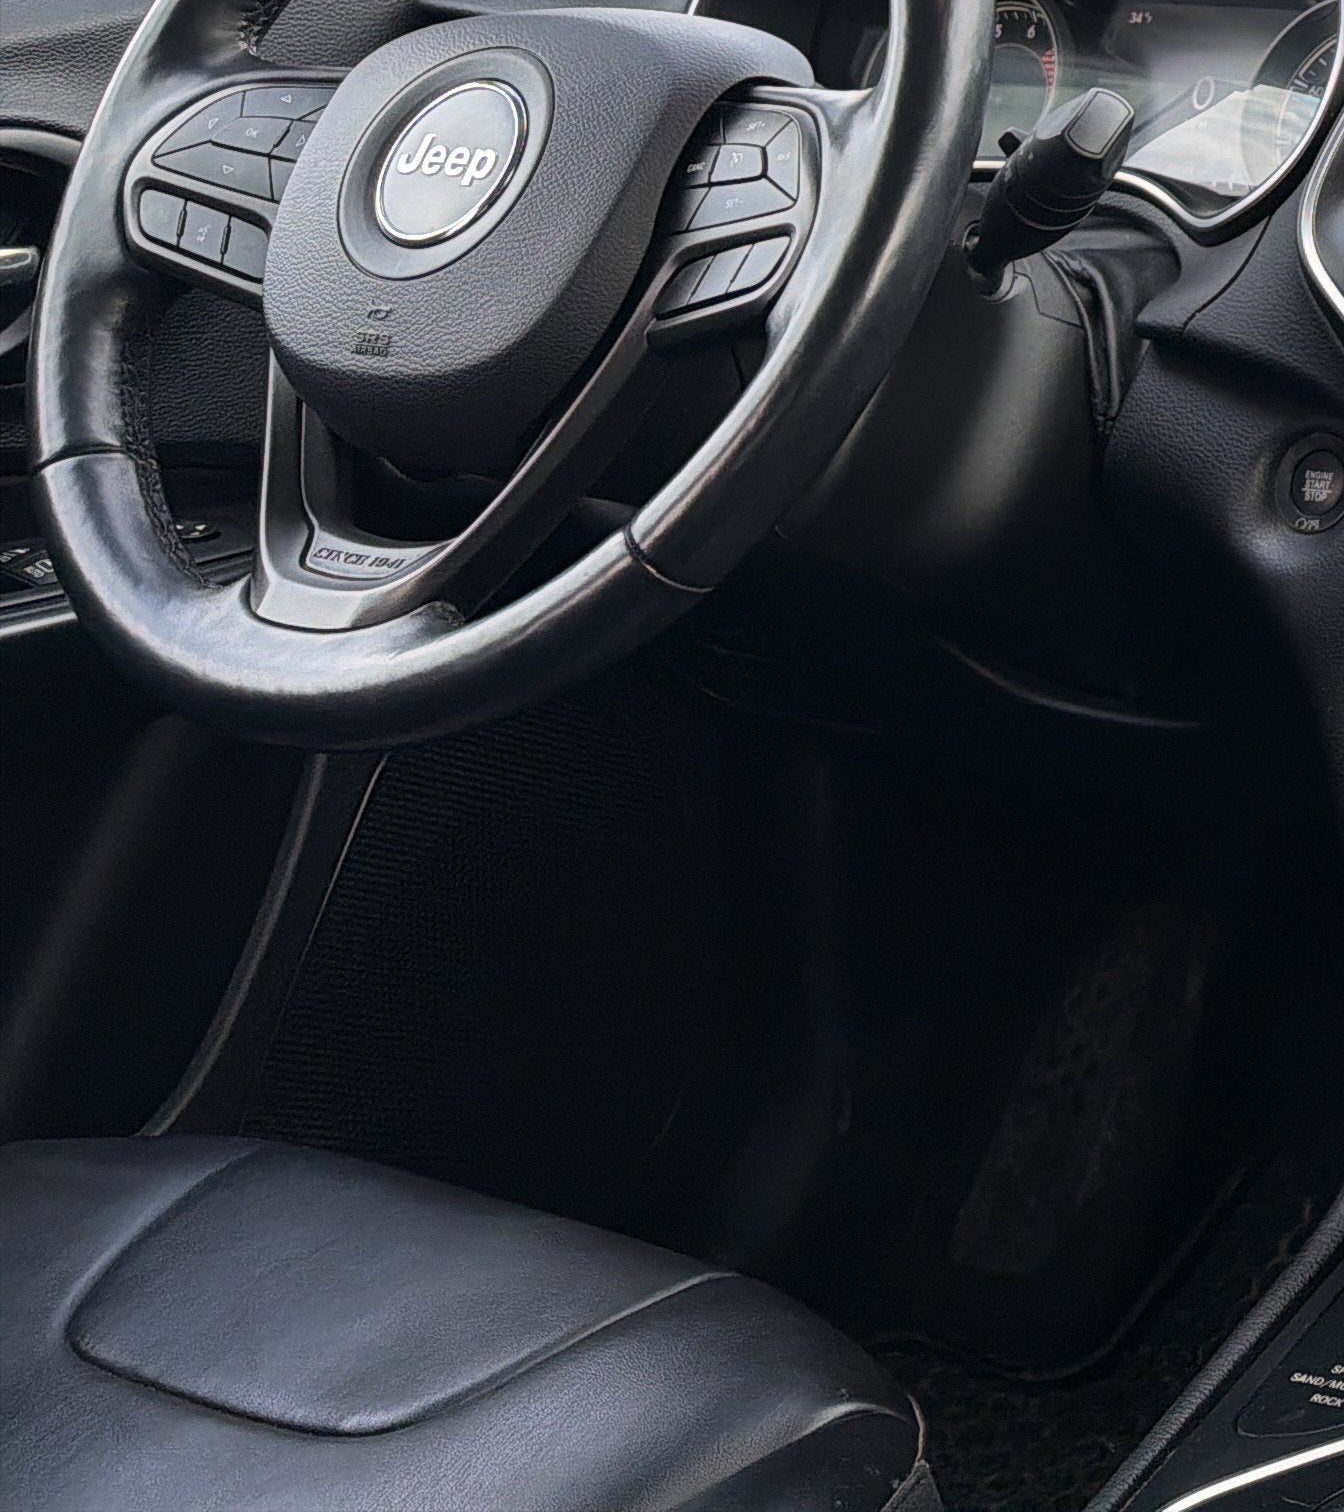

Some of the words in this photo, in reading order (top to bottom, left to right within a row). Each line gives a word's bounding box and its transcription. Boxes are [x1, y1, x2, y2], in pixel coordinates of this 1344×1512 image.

[1026, 24, 1036, 38] 6
[245, 127, 258, 138] OK
[397, 133, 498, 186] Jeep
[1305, 470, 1334, 481] ENGINE
[1304, 479, 1330, 490] START
[1304, 491, 1327, 502] STOP
[313, 547, 369, 567] SINCE
[368, 556, 406, 569] 1941
